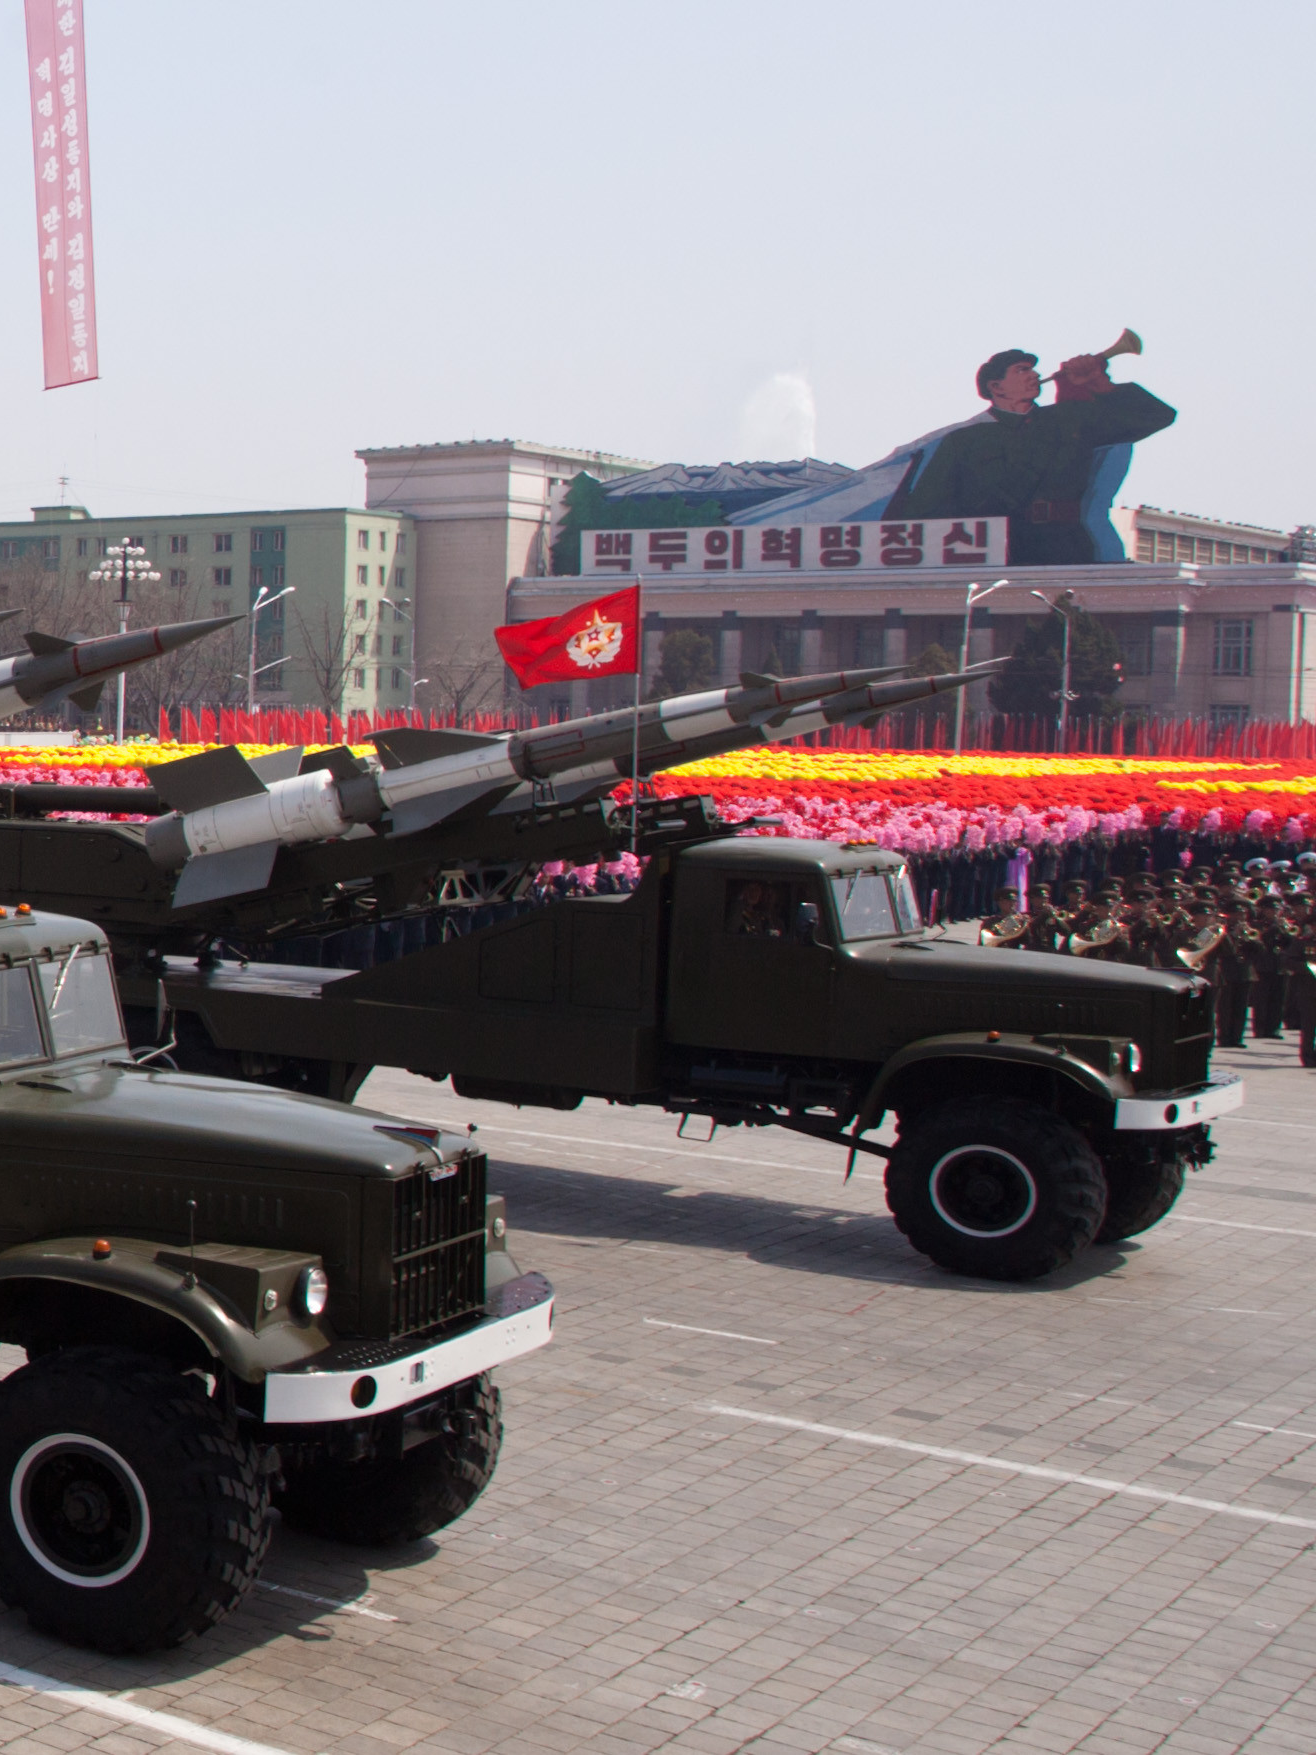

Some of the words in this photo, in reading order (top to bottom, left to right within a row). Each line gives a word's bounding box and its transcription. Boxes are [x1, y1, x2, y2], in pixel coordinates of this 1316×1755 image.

[57, 0, 77, 37] 한
[35, 57, 60, 183] 혁명사상
[58, 46, 84, 220] 김일성동지와
[42, 205, 61, 295] 만세!
[67, 232, 89, 375] 김정일동지
[595, 521, 987, 572] 백두의혁명정신
